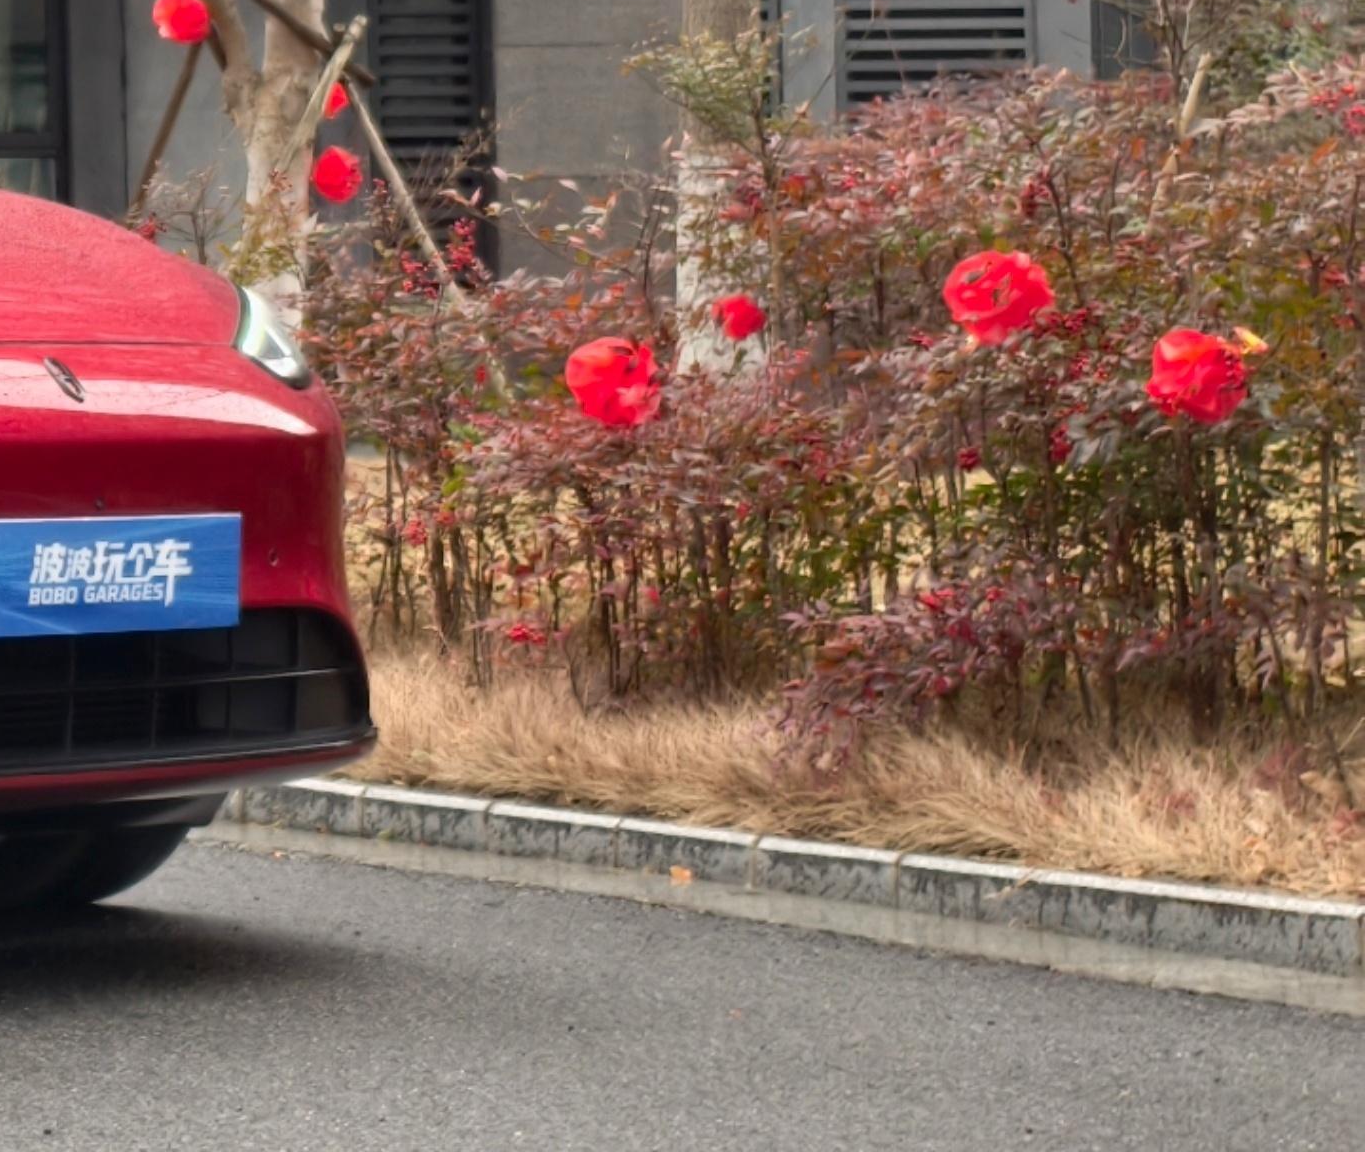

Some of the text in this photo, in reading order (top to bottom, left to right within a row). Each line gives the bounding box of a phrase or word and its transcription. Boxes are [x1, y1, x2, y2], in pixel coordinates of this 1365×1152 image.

[28, 583, 165, 606] BOBO GARAGES
[29, 538, 193, 607] 波波玩个车
